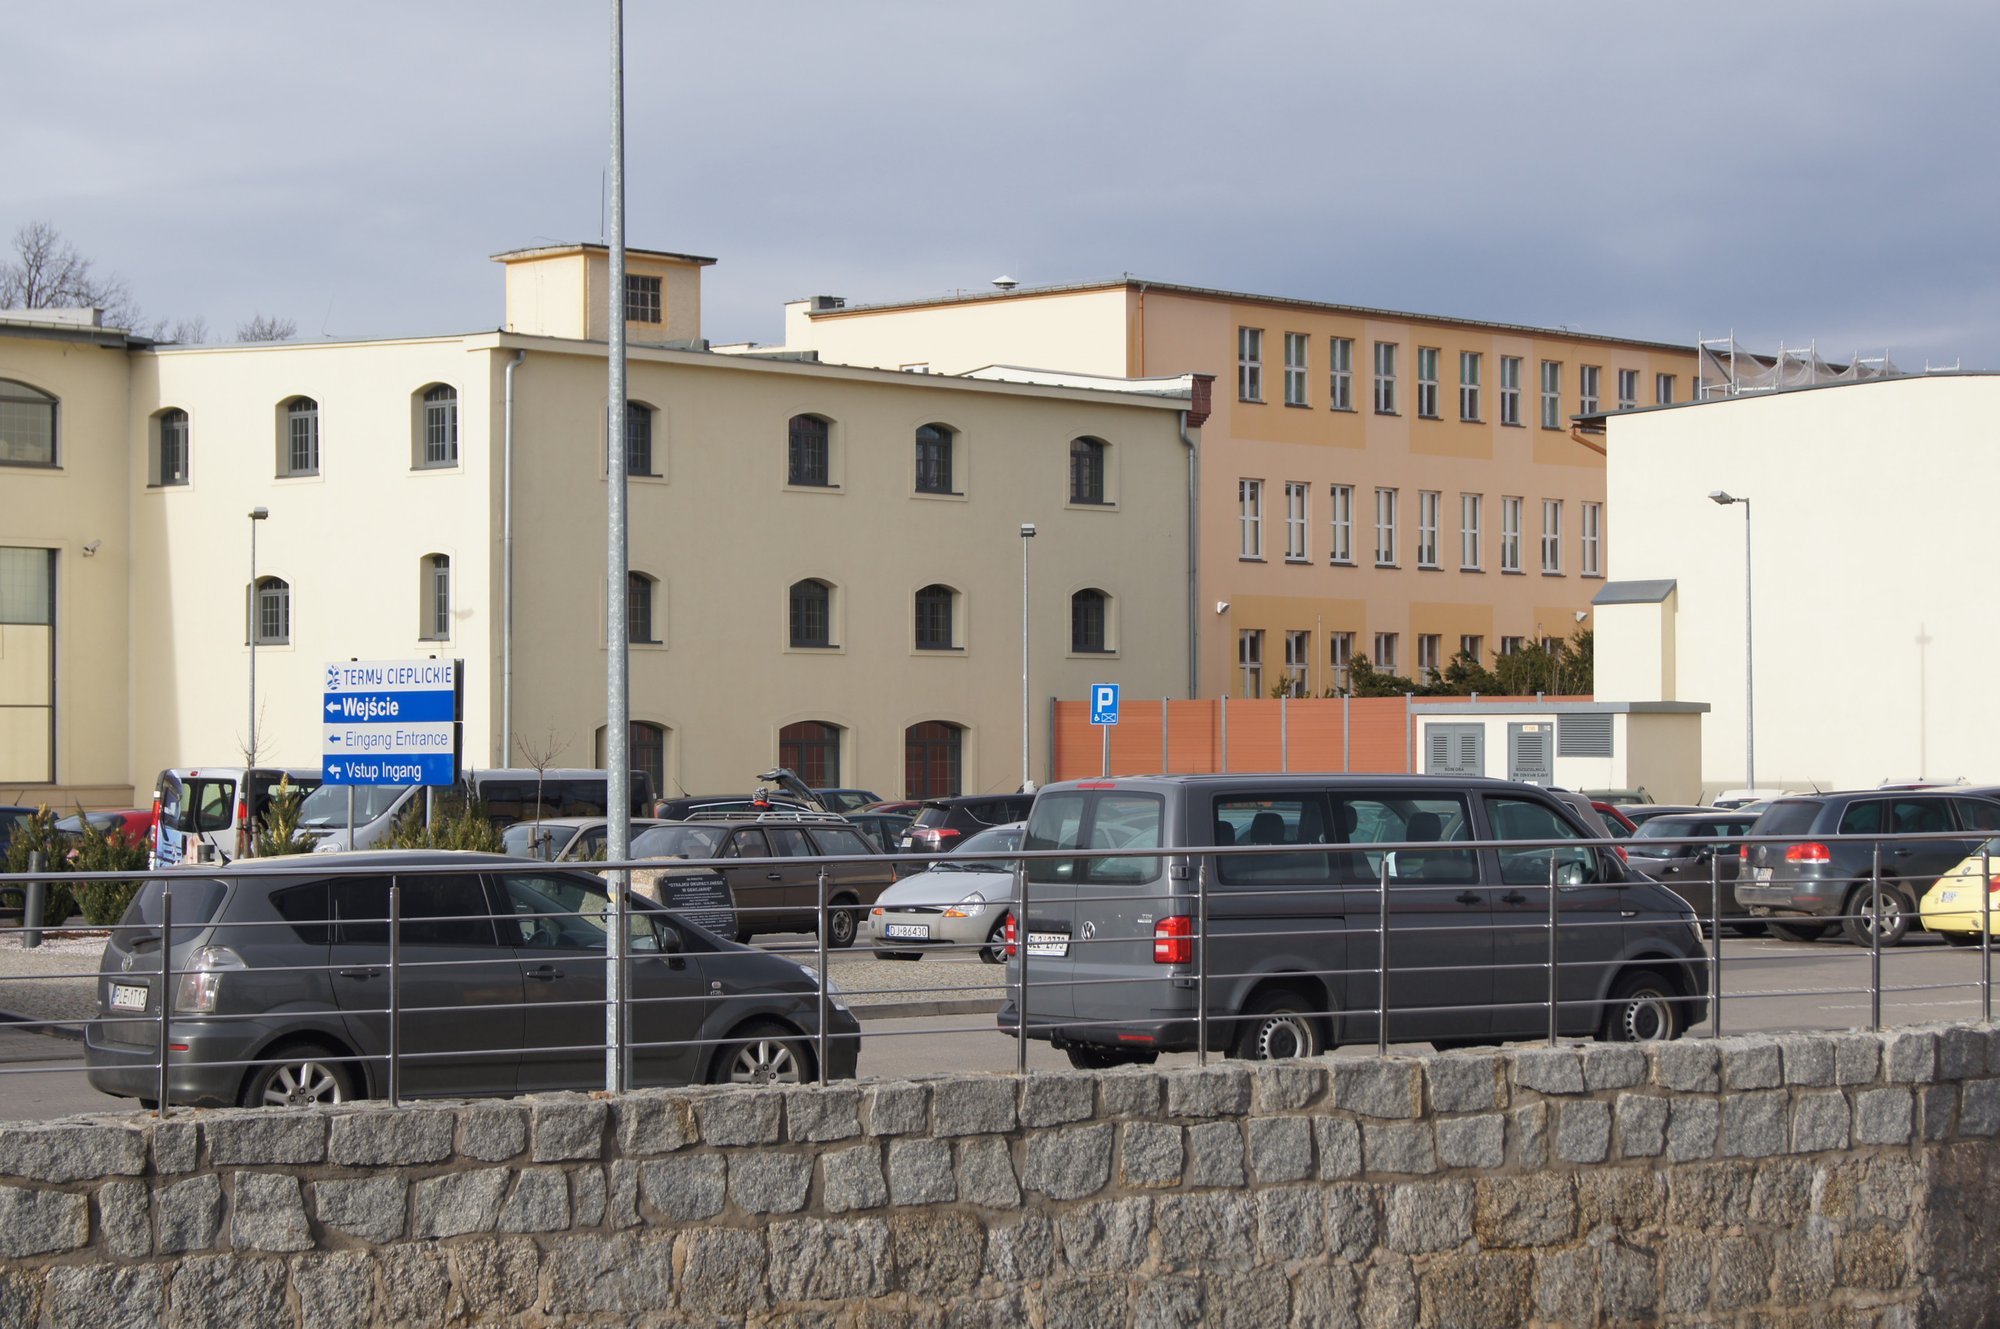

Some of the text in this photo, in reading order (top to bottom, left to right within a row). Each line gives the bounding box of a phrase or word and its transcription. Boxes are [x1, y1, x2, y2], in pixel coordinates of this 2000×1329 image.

[343, 666, 452, 685] TERMY CIEPLICKIE
[342, 697, 399, 721] Wejście
[1097, 687, 1113, 713] P
[345, 730, 448, 750] Eingang Entrance
[345, 761, 422, 782] Vstup Ingang
[890, 926, 927, 937] DJ 86430
